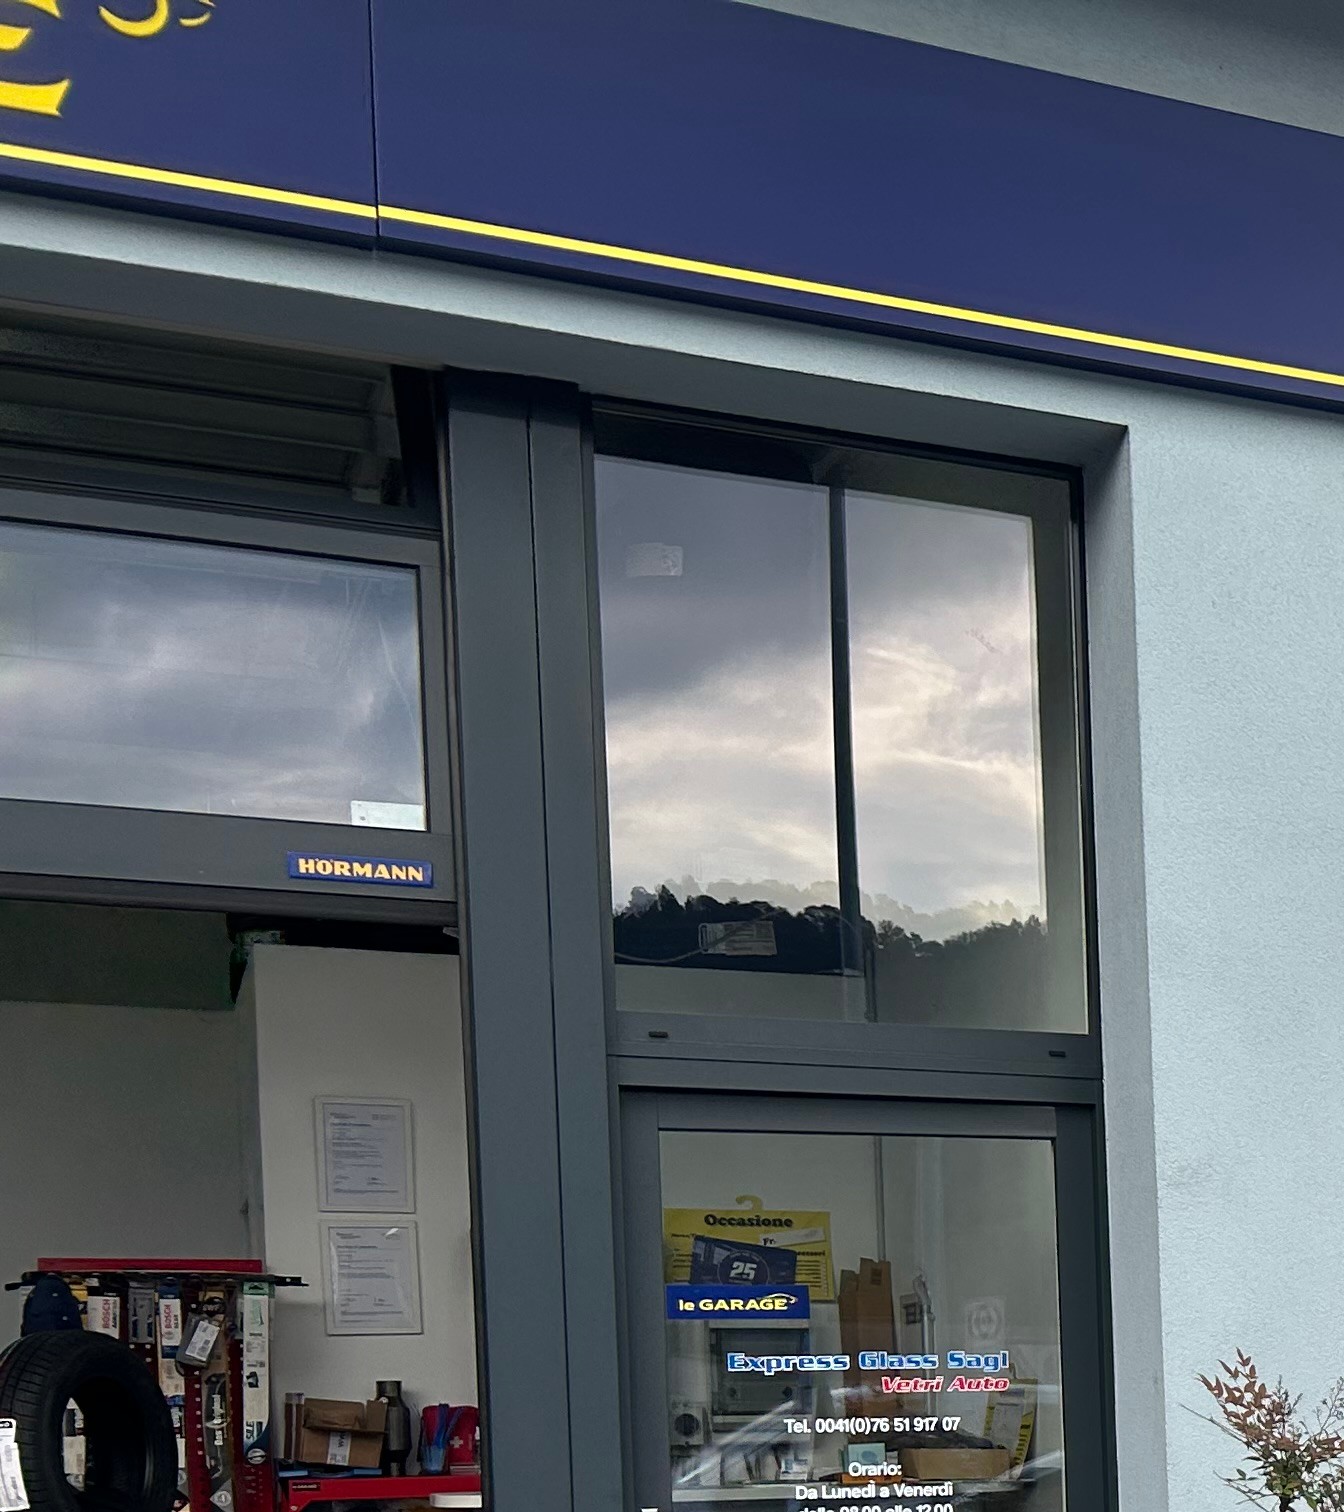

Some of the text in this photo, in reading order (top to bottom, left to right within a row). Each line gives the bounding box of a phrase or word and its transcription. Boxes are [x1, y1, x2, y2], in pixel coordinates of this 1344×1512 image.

[298, 857, 424, 881] HÖRMANN
[704, 1213, 794, 1228] Occasione
[729, 1261, 758, 1281] 25
[102, 1298, 113, 1329] BOSCH
[679, 1299, 789, 1312] le GARAGE
[163, 1304, 172, 1329] BOSCH
[727, 1350, 1010, 1376] Express Glass Sagl
[881, 1375, 1010, 1393] Vetri Auto
[784, 1416, 961, 1435] Tel. 0041(0)76 51 917 07
[848, 1461, 902, 1477] Orario:
[795, 1485, 815, 1500] Da
[879, 1487, 890, 1498] a
